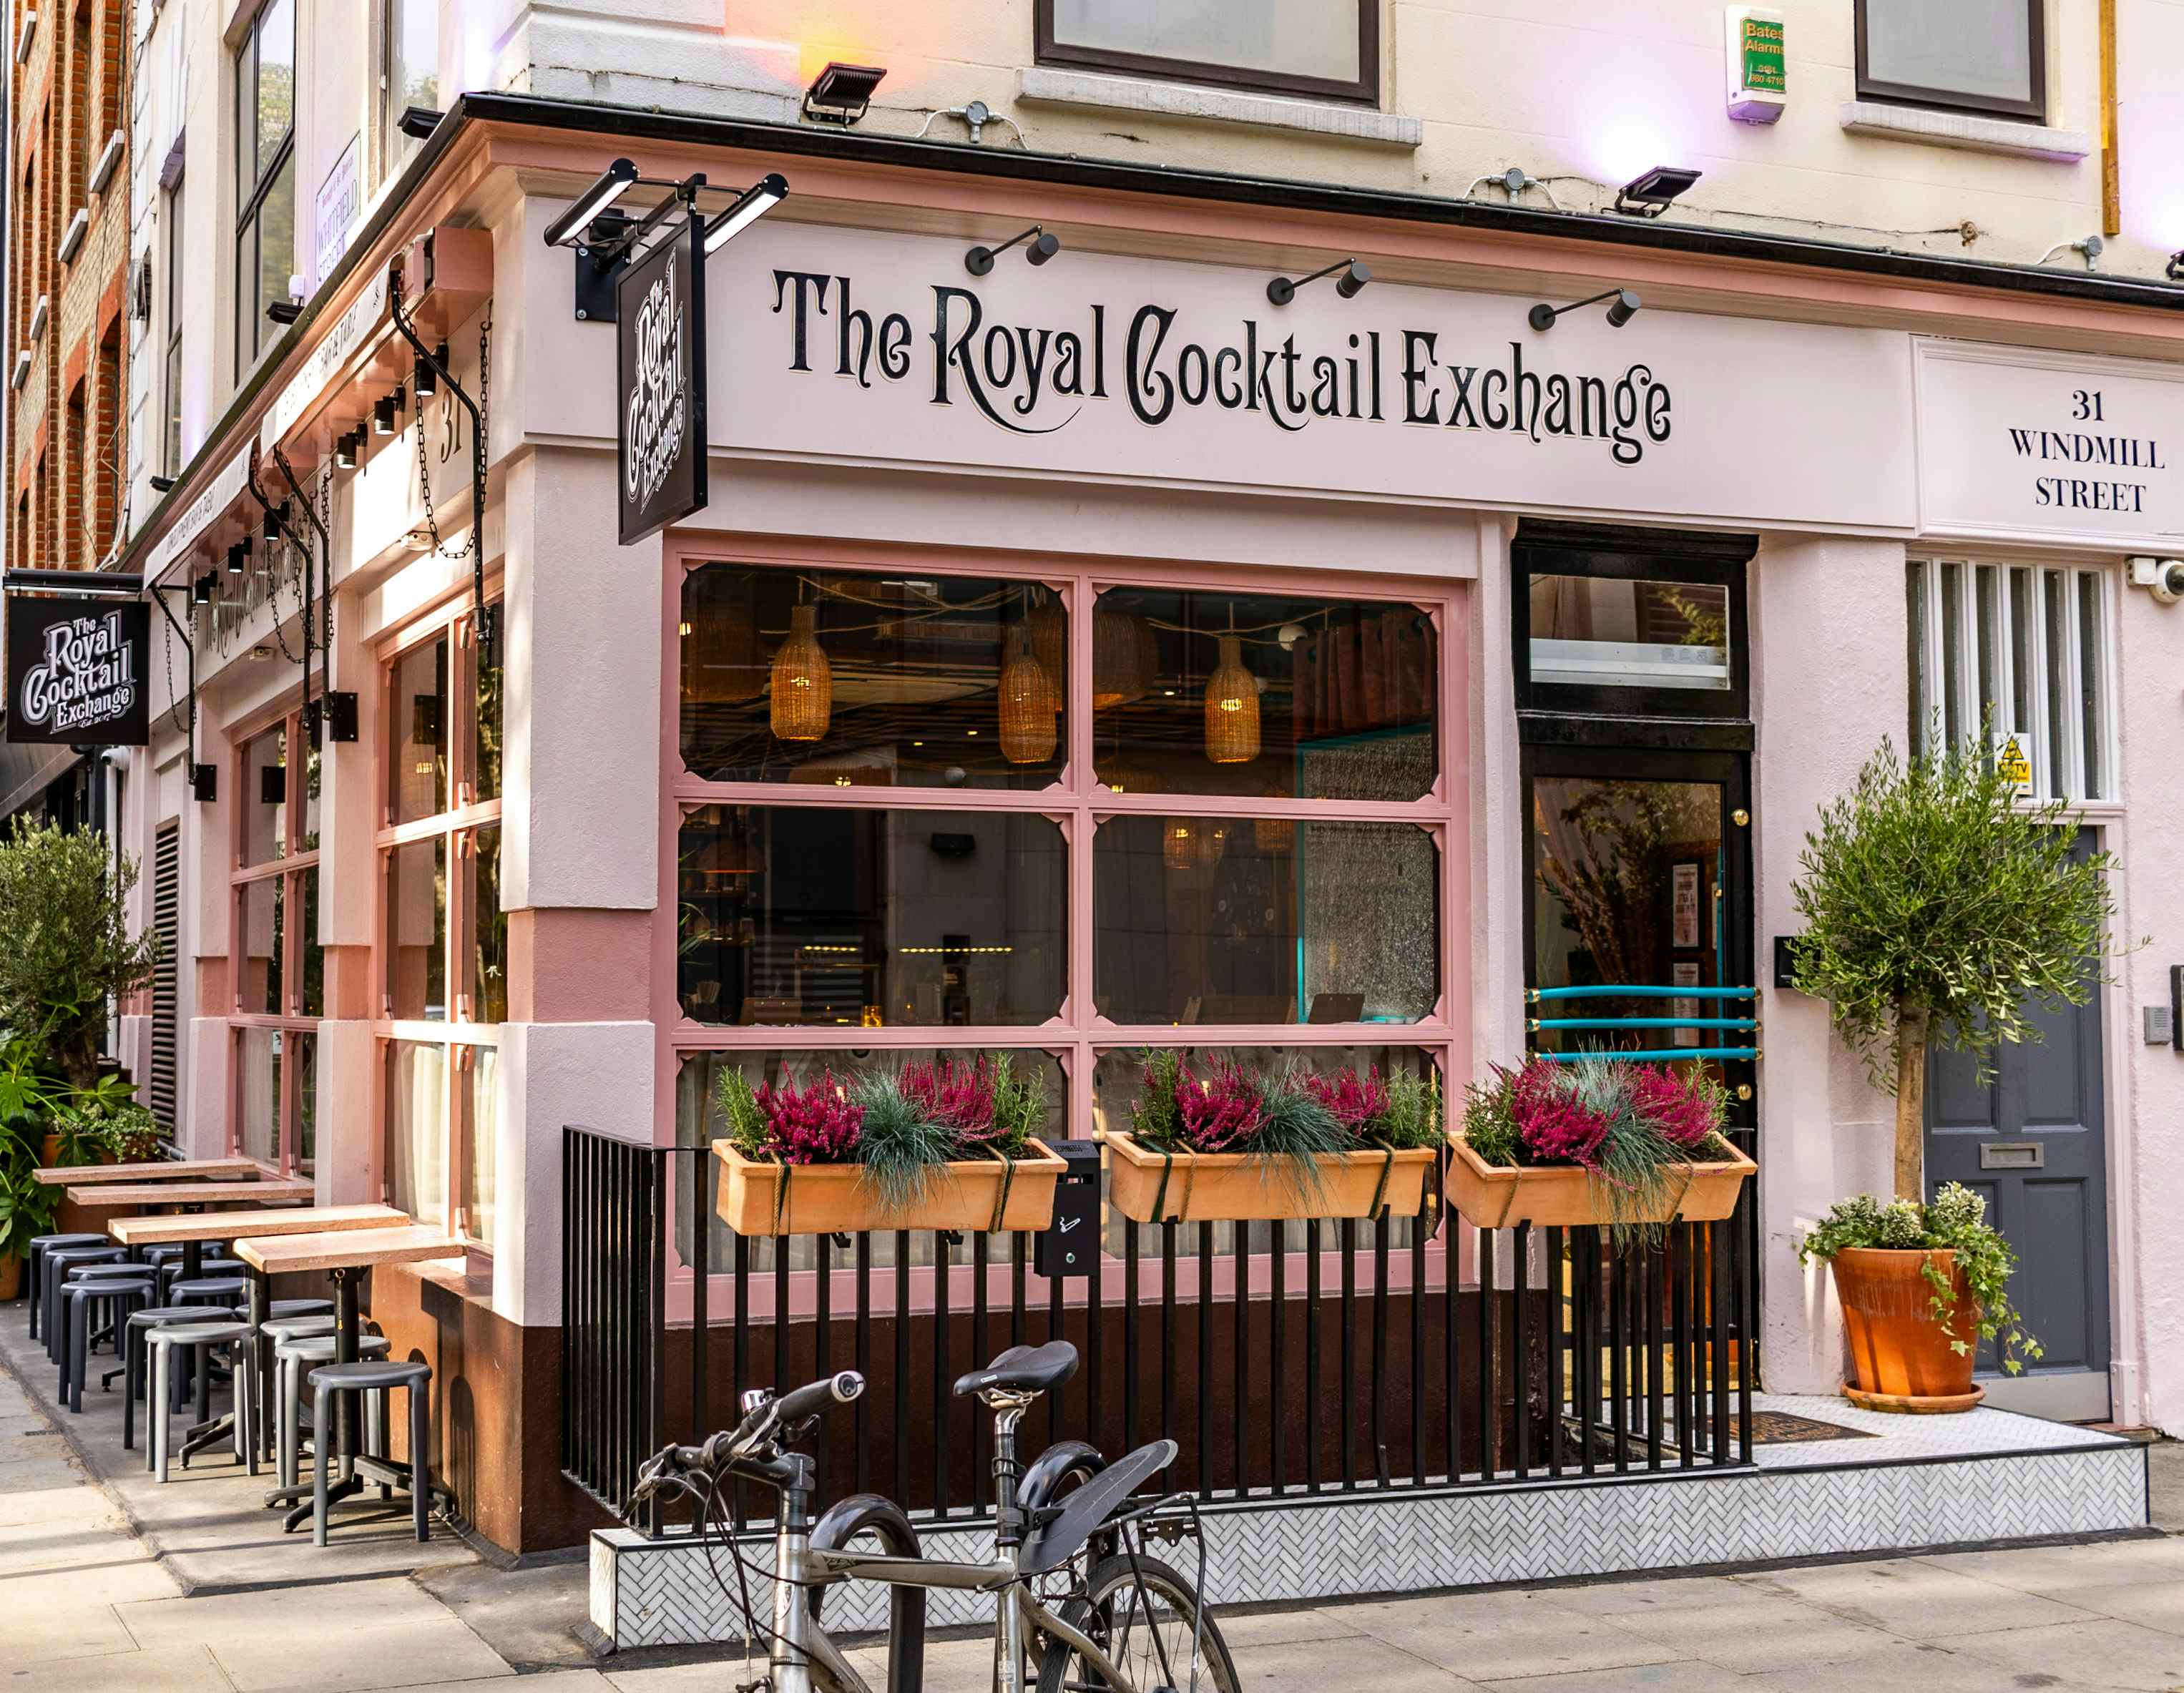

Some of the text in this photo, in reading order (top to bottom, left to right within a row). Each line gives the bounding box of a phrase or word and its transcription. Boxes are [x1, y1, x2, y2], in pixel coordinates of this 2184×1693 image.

[1745, 39, 1784, 54] Alarms
[1746, 22, 1783, 39] Bates
[650, 280, 663, 319] The
[637, 262, 675, 413] Royal
[772, 269, 1671, 464] The Royal Cocktail Exchange
[441, 373, 461, 463] 31
[628, 317, 682, 496] Cocktail
[2072, 390, 2105, 421] 31
[644, 398, 683, 499] Exchange
[2008, 428, 2166, 469] WINDMILL
[2035, 476, 2147, 513] STREET
[48, 616, 117, 680] Royal
[73, 617, 97, 637] The
[25, 647, 128, 721] Cocktail
[56, 686, 130, 728] Exchange
